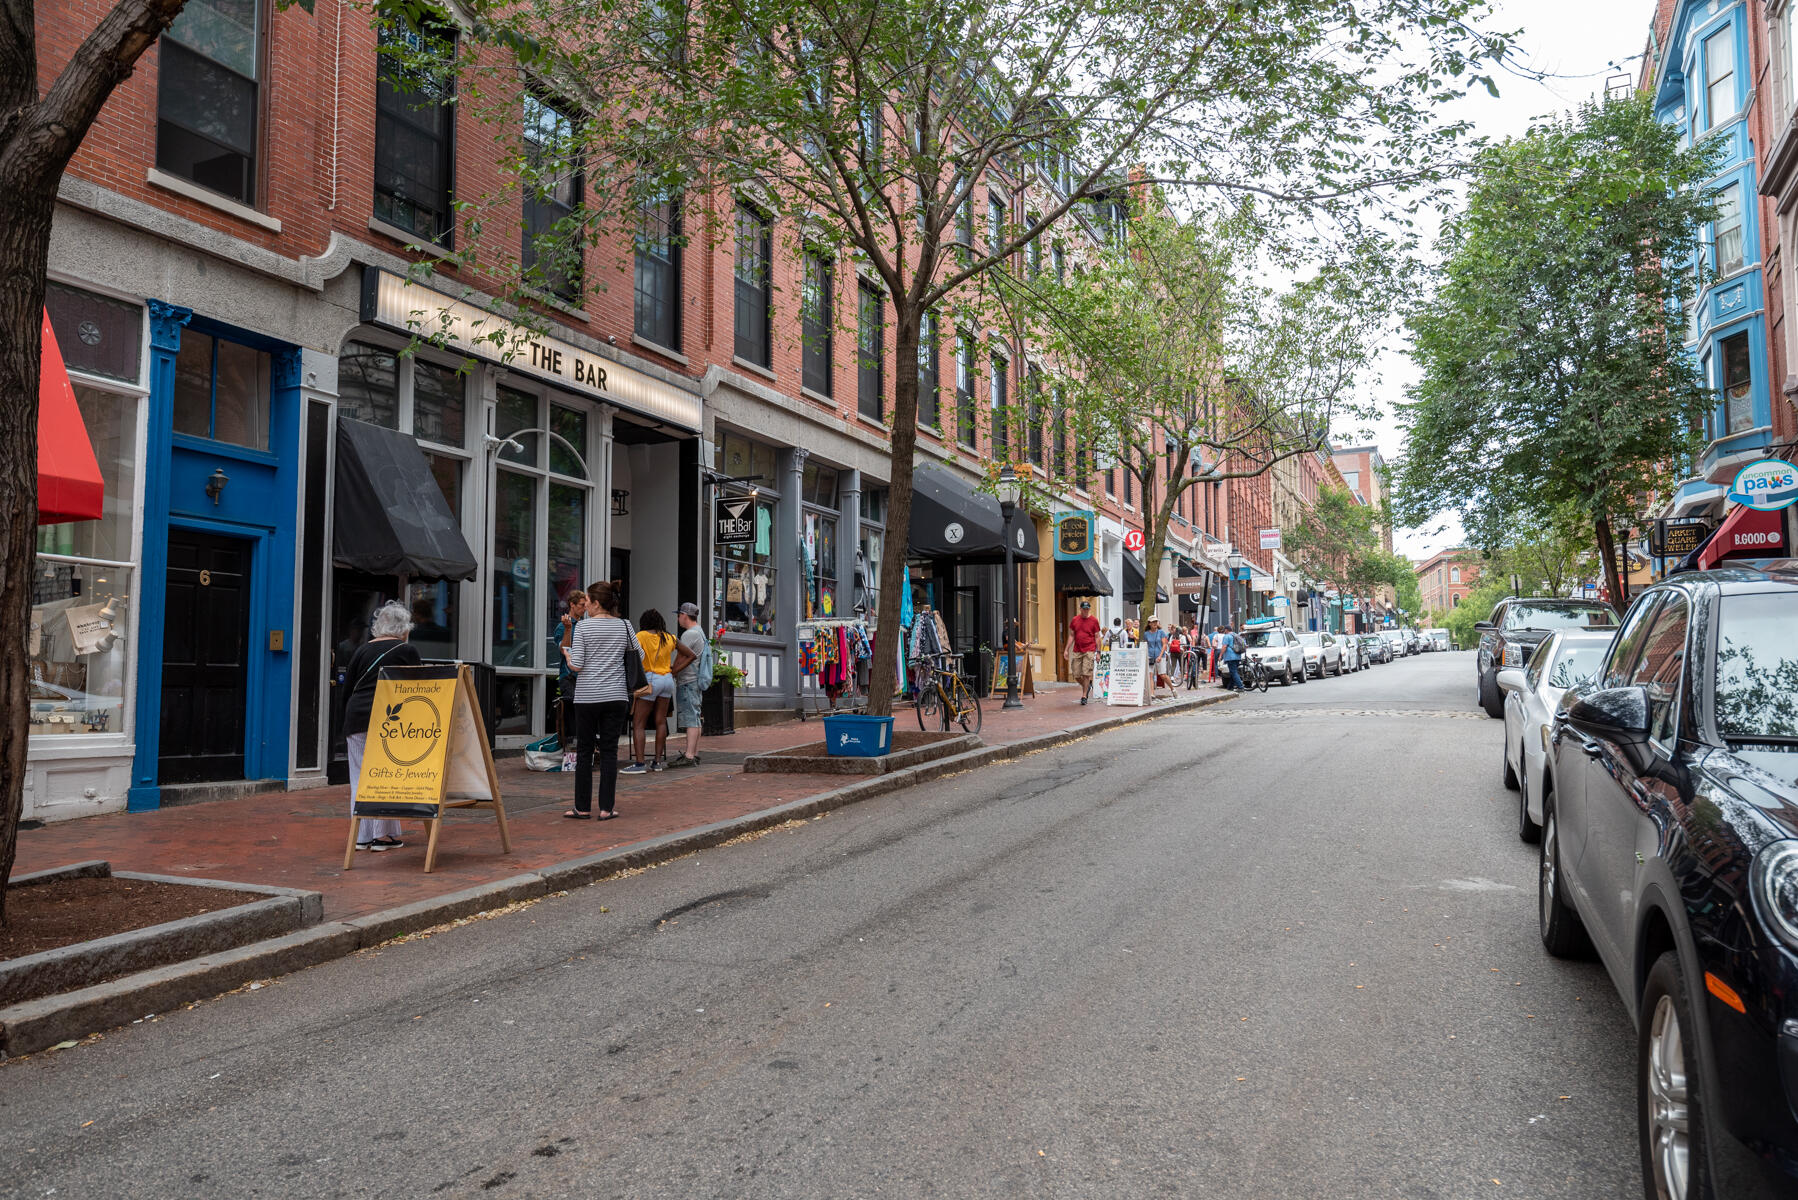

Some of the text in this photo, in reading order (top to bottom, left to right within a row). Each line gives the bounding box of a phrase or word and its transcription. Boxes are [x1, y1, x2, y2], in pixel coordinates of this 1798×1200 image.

[529, 341, 607, 391] THE BAR
[1742, 468, 1792, 479] uncommon
[1744, 474, 1794, 494] paws
[718, 518, 752, 534] THE Bar
[950, 528, 959, 539] X
[1669, 529, 1696, 537] ARKET
[1734, 532, 1767, 545] B.GOOD
[1668, 536, 1697, 545] QUARE
[199, 569, 211, 586] 6
[394, 683, 441, 694] Handmade
[368, 767, 438, 782] Gifts & Jewelry
